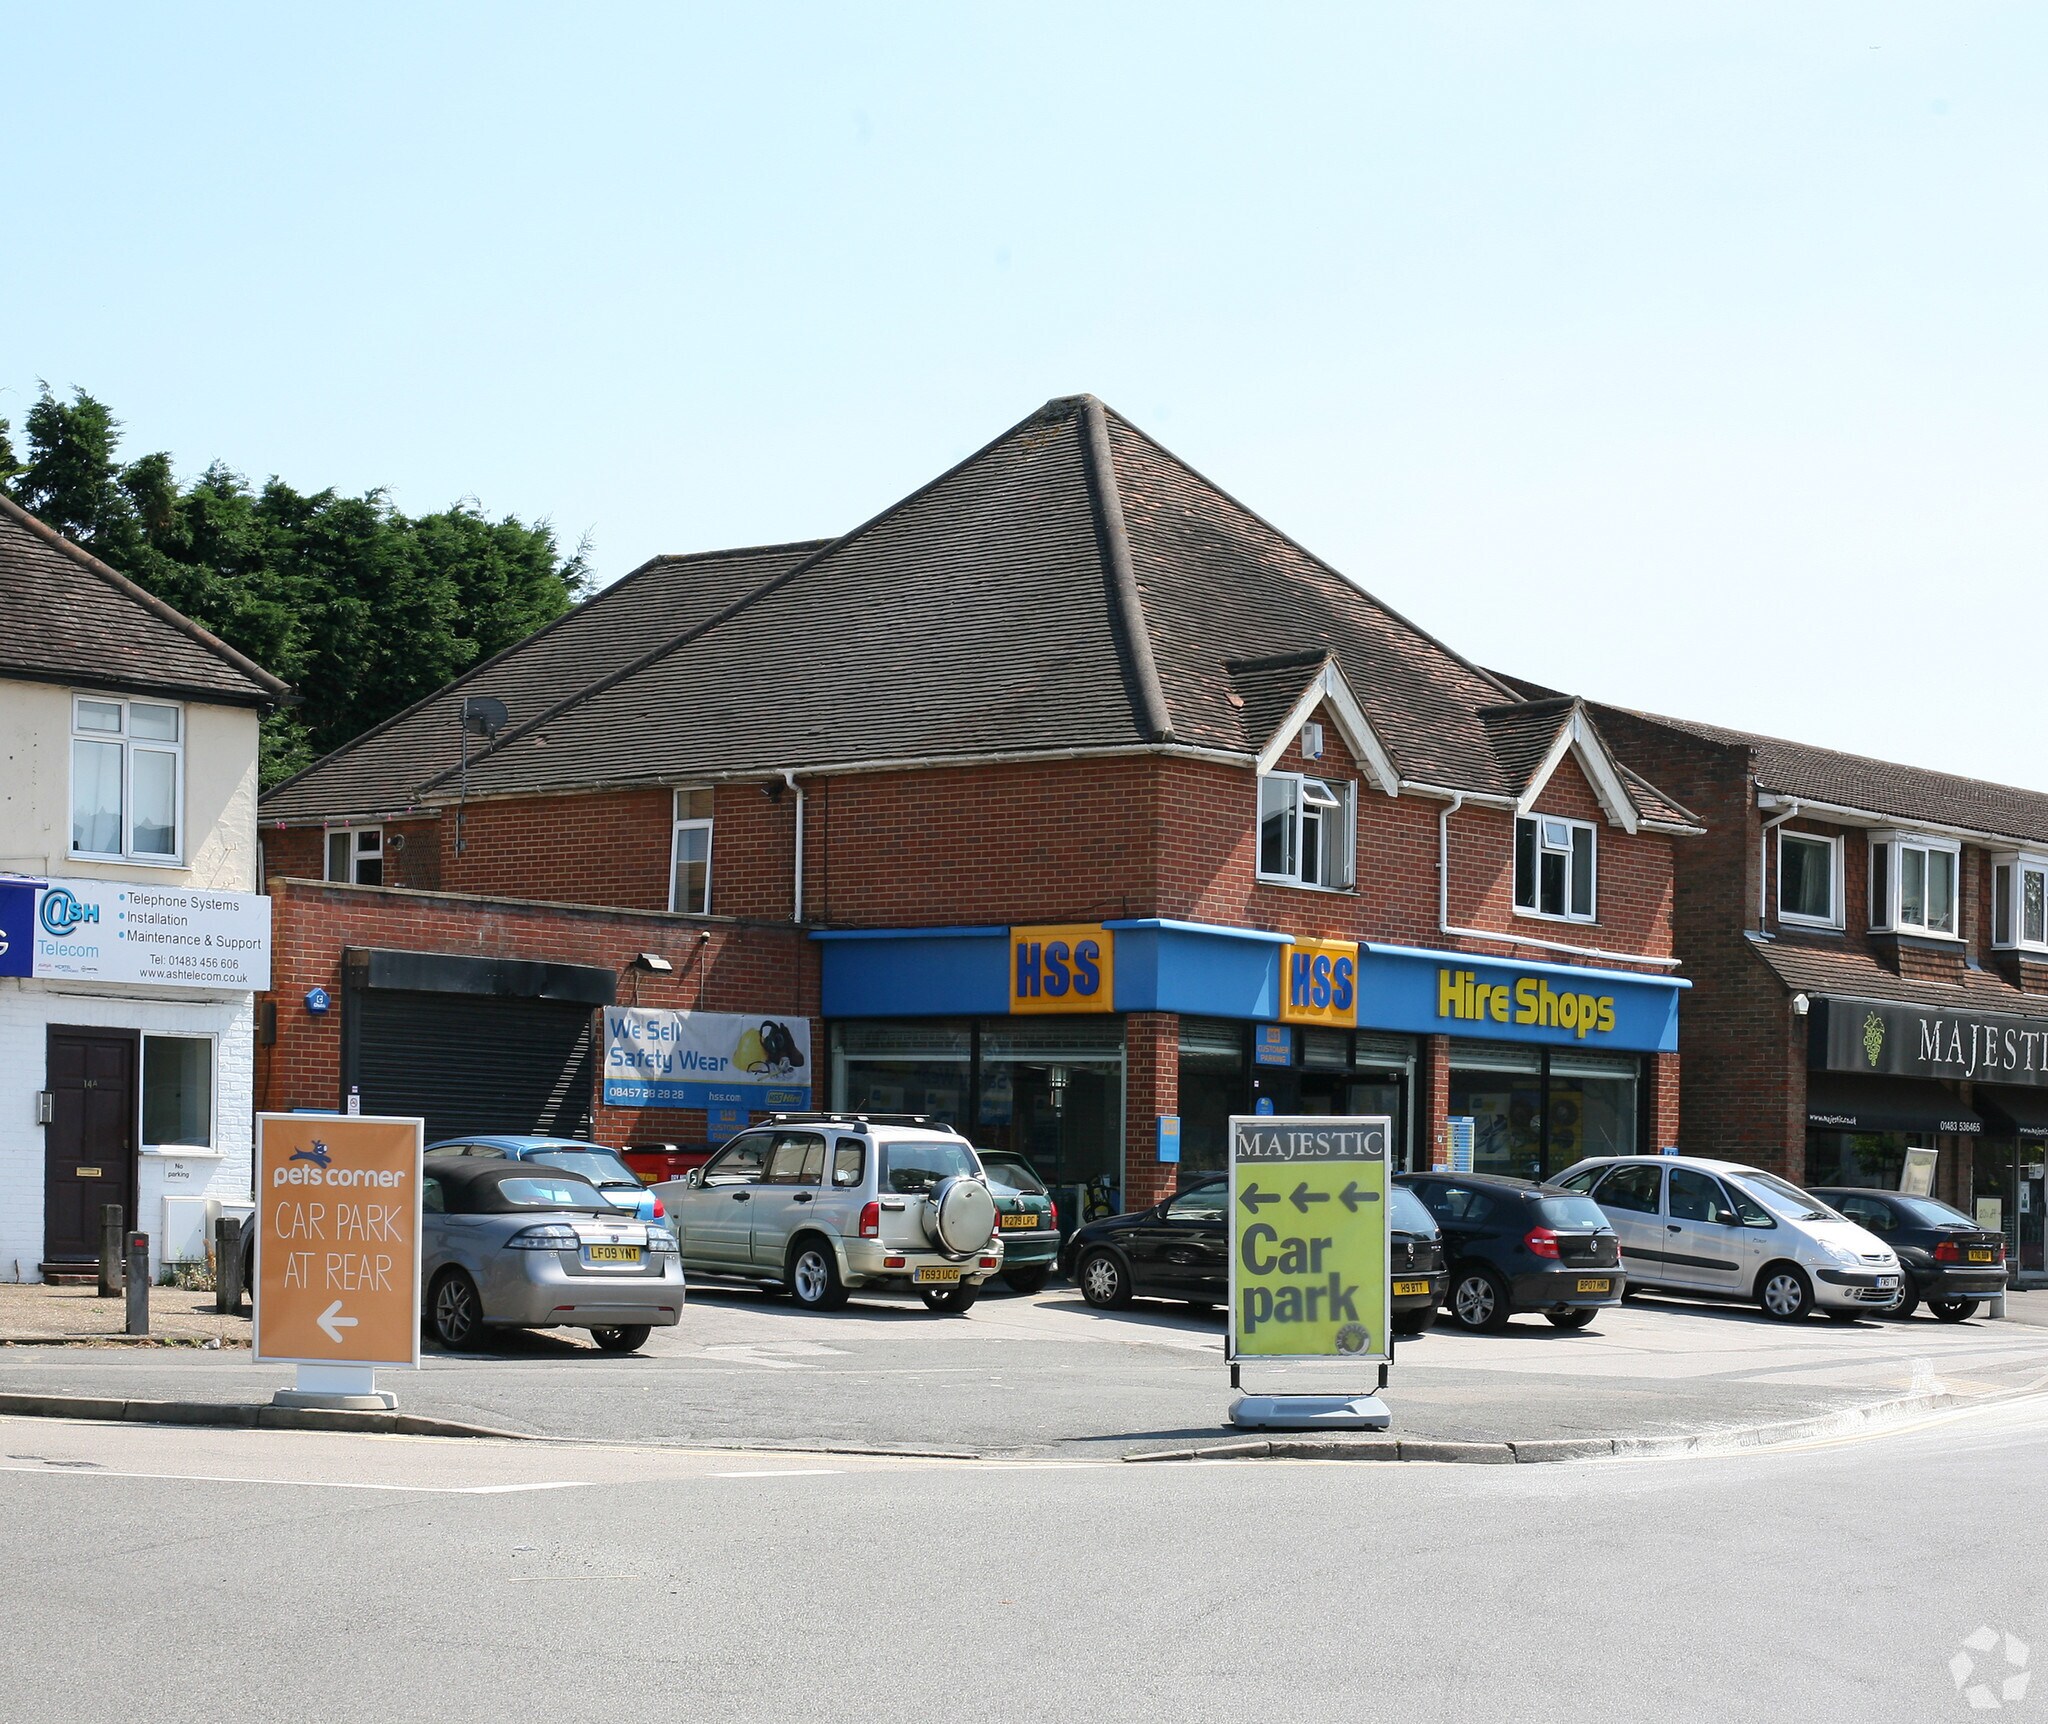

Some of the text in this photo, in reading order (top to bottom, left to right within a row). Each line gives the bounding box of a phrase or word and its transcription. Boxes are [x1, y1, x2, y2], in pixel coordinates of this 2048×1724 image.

[128, 892, 240, 912] Telephone Systems
[127, 911, 188, 926] Installation
[38, 939, 99, 958] Telecom
[127, 930, 262, 951] Maintenance & Support
[149, 953, 239, 970] Tel: 01483 456 606
[1016, 939, 1100, 997] HSS
[140, 968, 248, 983] www.ashtelecom.co.uk
[1290, 952, 1353, 1010] HSS
[1437, 967, 1616, 1039] Hire Shops
[610, 1018, 681, 1042] We Sell
[1257, 1045, 1289, 1054] CUSTOMER
[1261, 1055, 1286, 1063] PARKING
[610, 1046, 728, 1074] Safety Wear
[83, 1079, 98, 1089] 14A
[609, 1086, 684, 1100] 08457 28 28 28
[708, 1091, 742, 1102] hss.com
[1940, 1120, 1981, 1134] 01483 536465
[1236, 1131, 1383, 1160] MAJESTIC
[167, 1170, 190, 1179] parking
[174, 1162, 184, 1170] No
[273, 1163, 405, 1188] pets corner
[275, 1201, 402, 1242] CAR PARK
[590, 1247, 638, 1260] LF09 YNT
[1241, 1222, 1333, 1276] Car
[284, 1252, 392, 1292] AT REAR
[920, 1268, 960, 1281] T693 UCG
[1243, 1272, 1359, 1334] park
